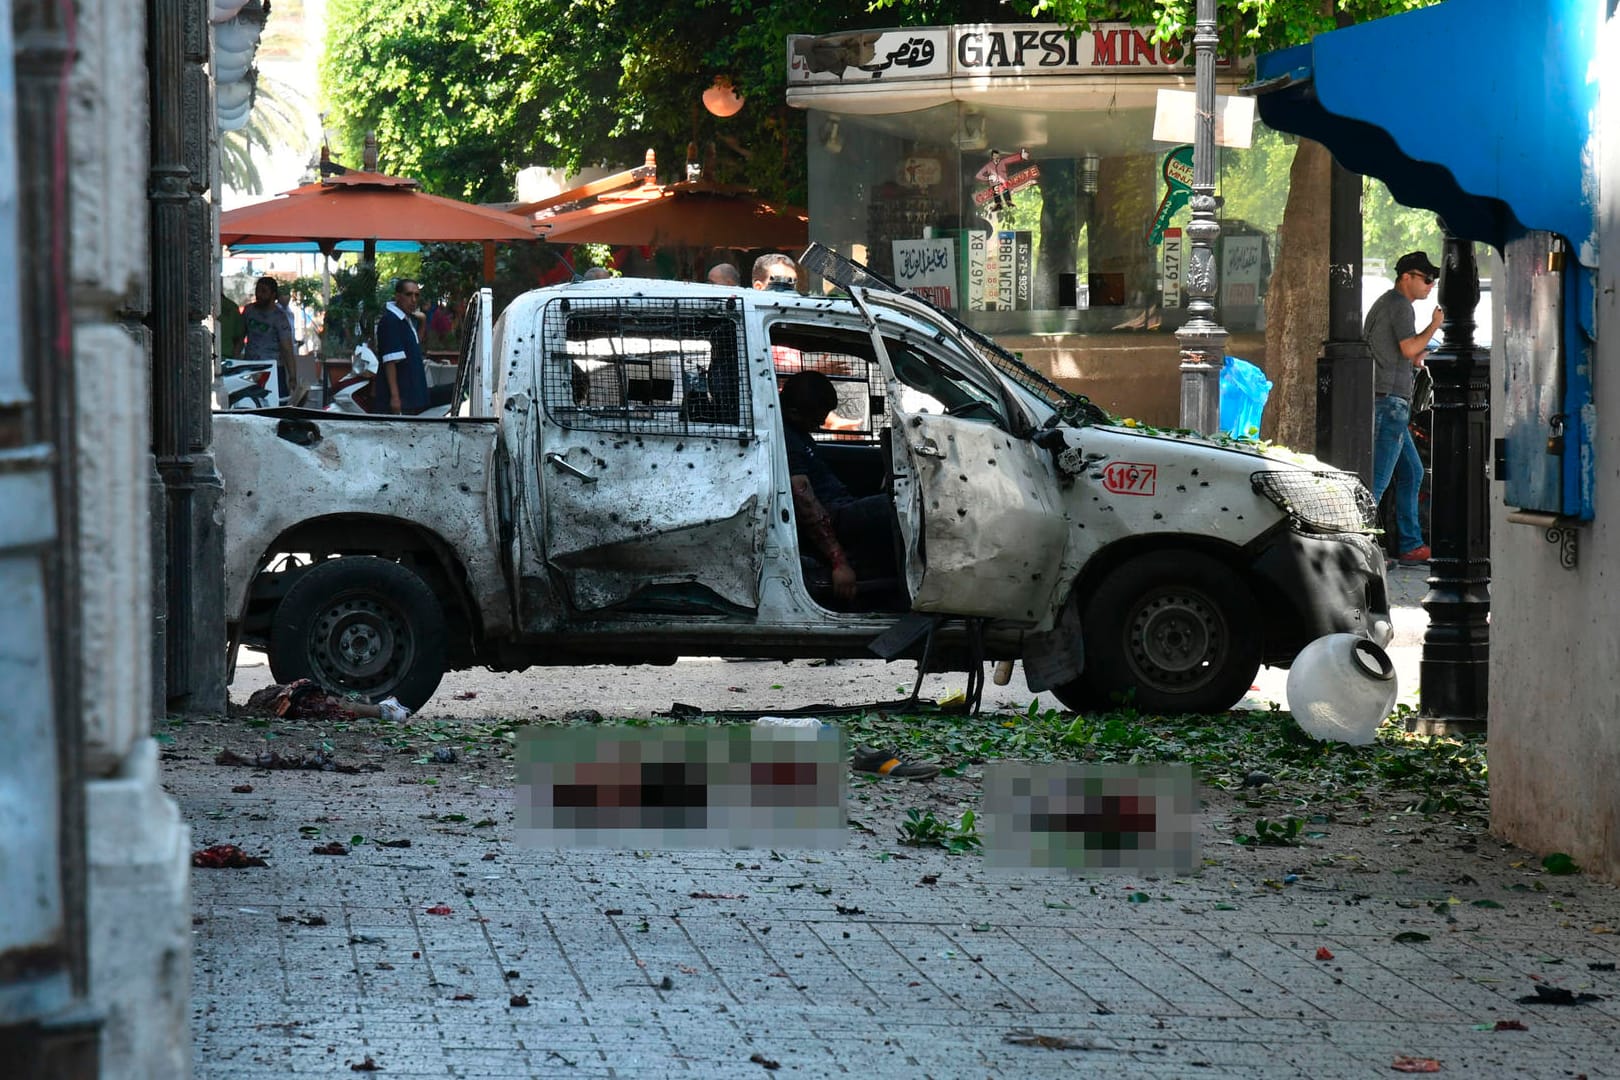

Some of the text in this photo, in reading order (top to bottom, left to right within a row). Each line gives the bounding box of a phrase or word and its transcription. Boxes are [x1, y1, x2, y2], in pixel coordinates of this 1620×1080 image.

[958, 29, 1230, 68] GAFSI MINU
[1117, 467, 1153, 490] 197
